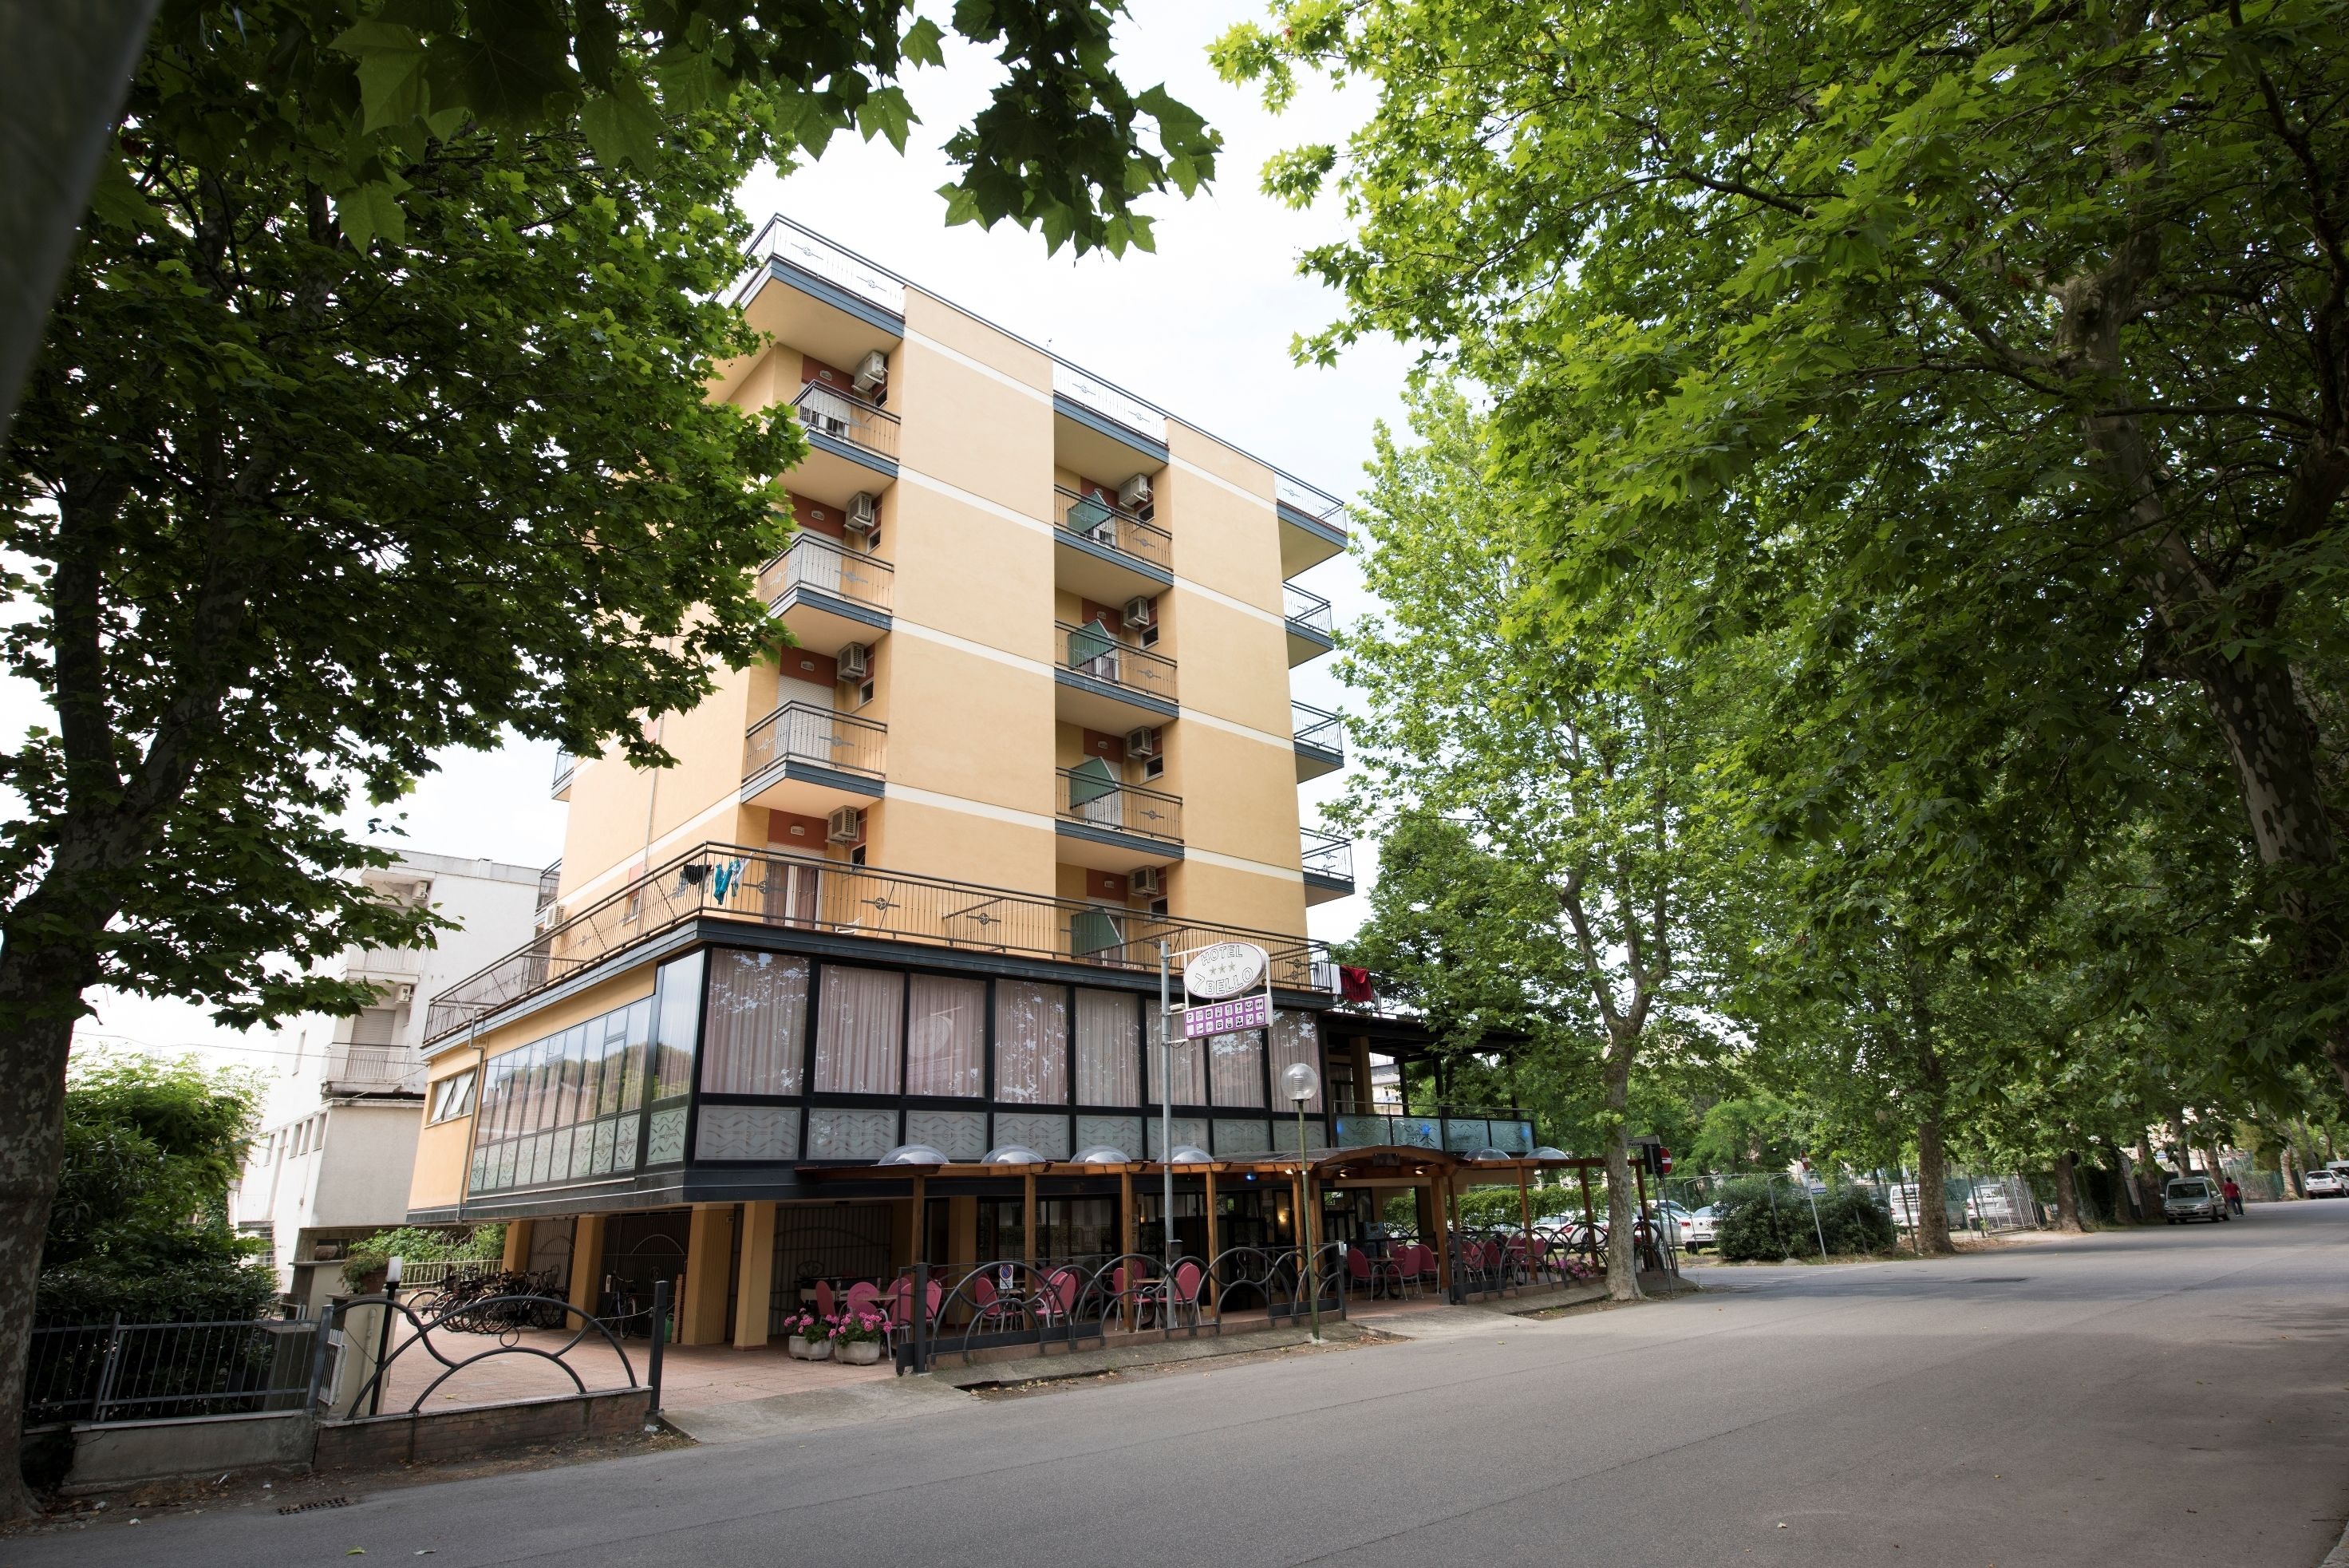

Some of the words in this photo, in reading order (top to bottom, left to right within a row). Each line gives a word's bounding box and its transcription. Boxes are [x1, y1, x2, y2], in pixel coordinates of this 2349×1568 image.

[1200, 945, 1243, 966] HOTEL
[1193, 973, 1206, 993] 7
[1206, 966, 1253, 995] BELLO
